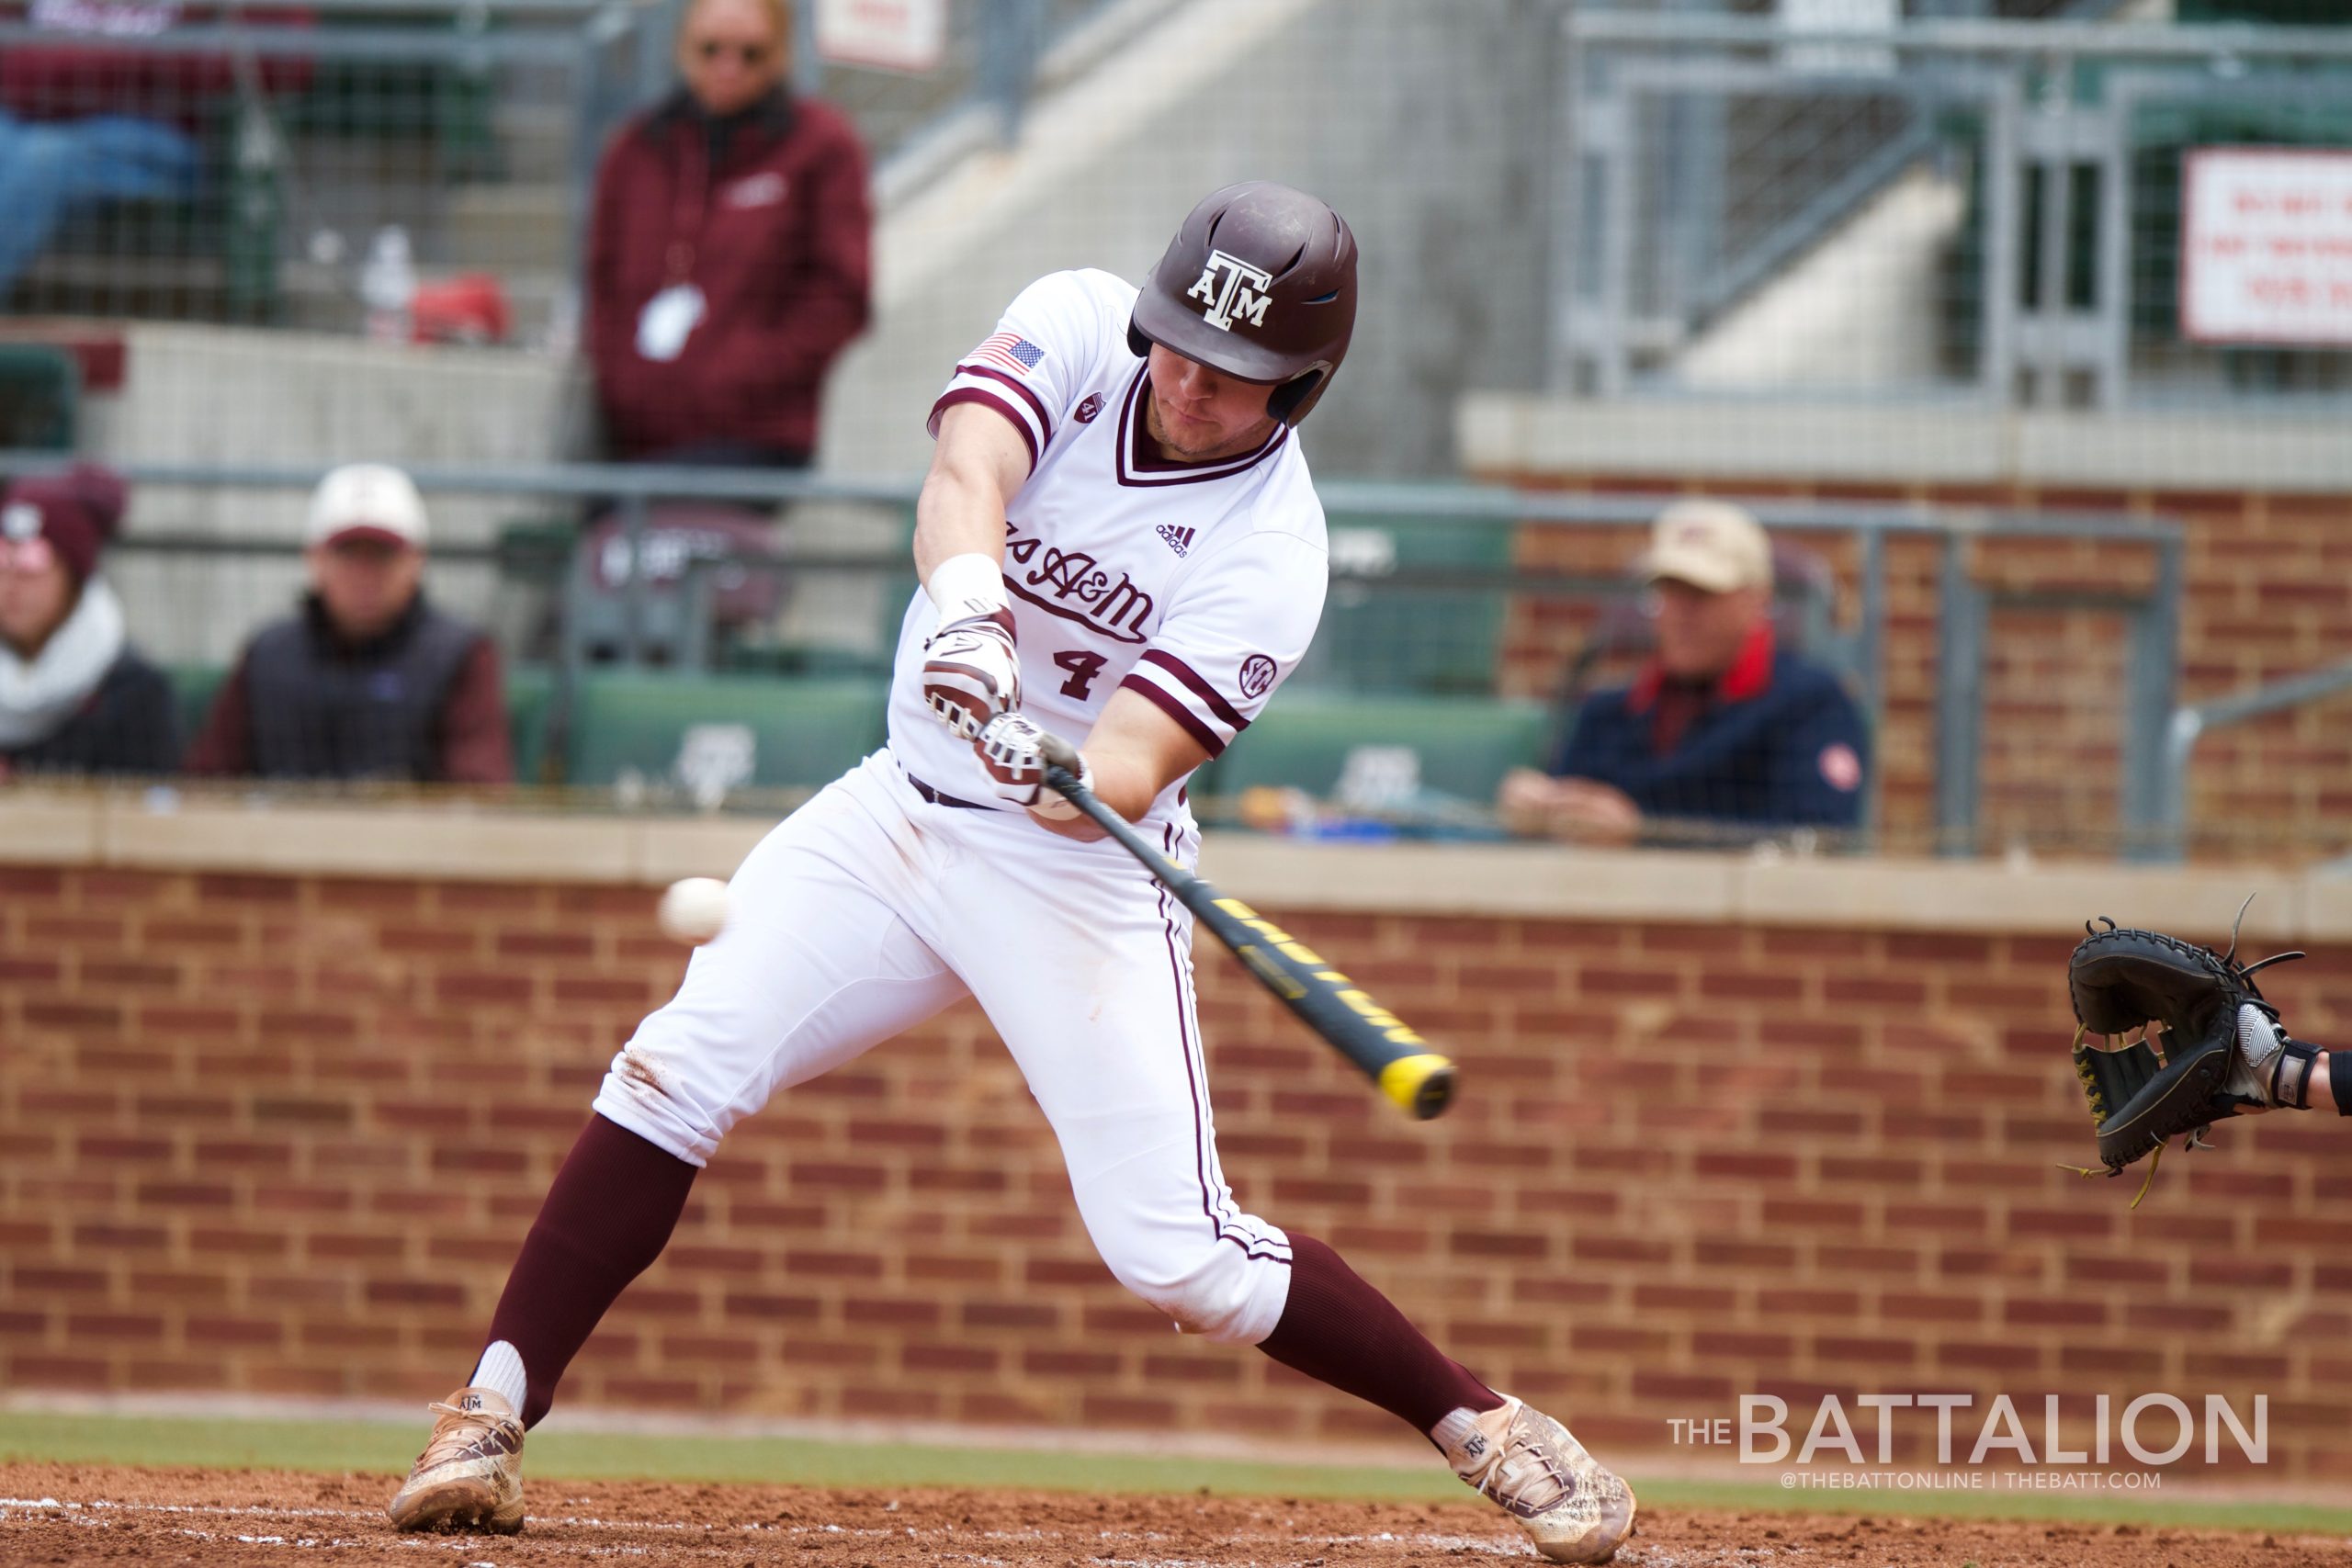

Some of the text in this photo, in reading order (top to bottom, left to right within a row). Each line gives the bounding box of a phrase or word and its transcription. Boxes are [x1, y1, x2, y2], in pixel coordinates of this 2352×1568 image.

[1082, 402, 1097, 422] 41
[1156, 525, 1187, 558] adidas
[1053, 650, 1109, 702] 4
